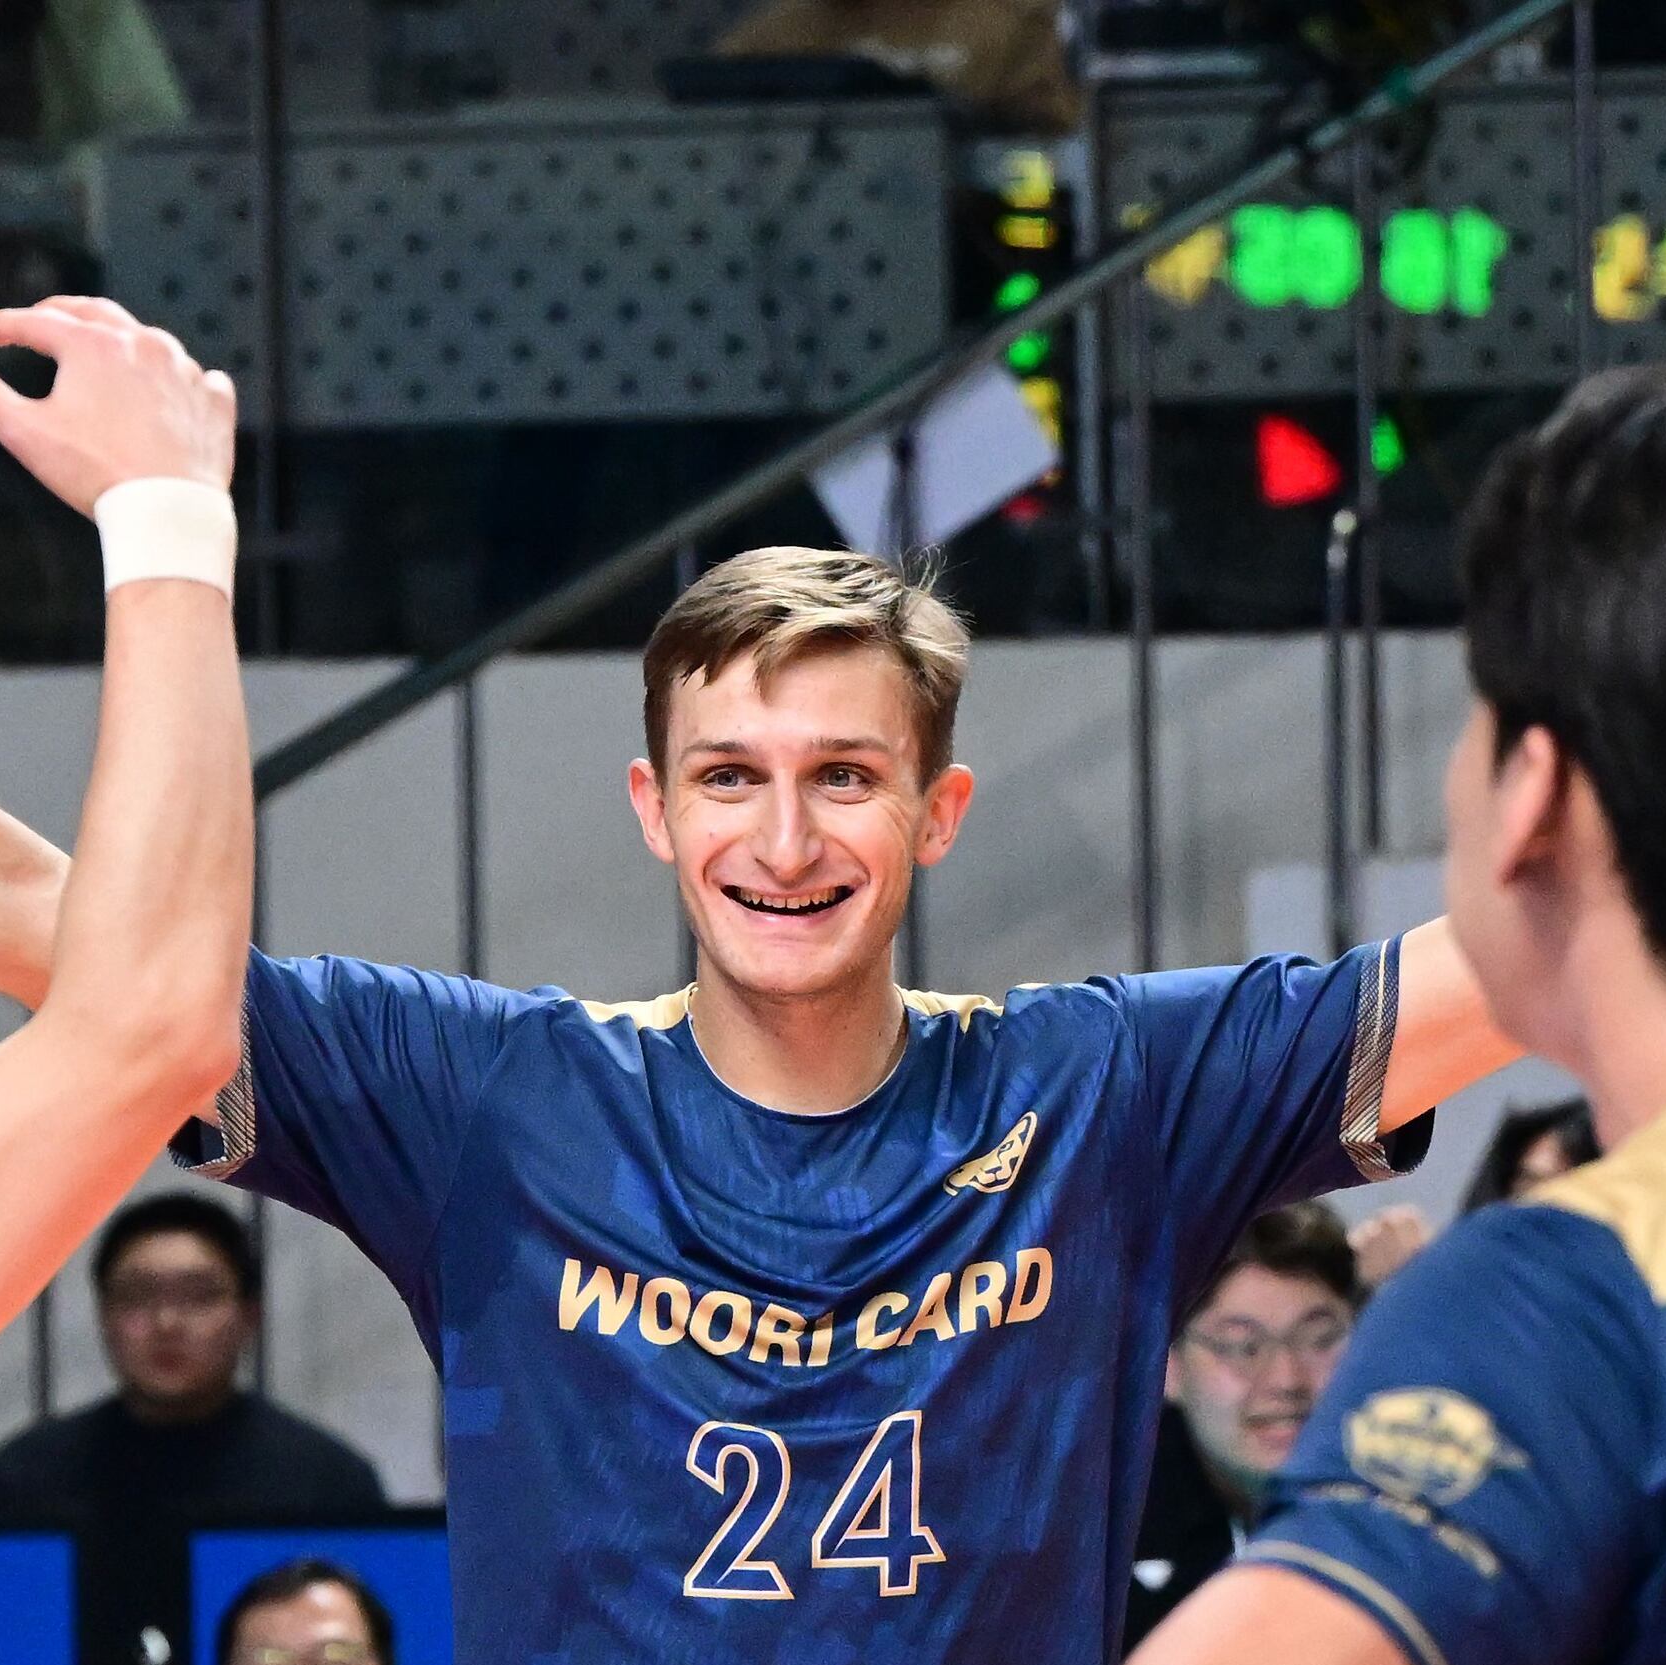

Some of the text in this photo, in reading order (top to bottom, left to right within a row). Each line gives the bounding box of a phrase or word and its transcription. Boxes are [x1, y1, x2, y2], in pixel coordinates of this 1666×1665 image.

[557, 1247, 1054, 1367] WOORI CARD
[683, 1409, 948, 1600] 24
